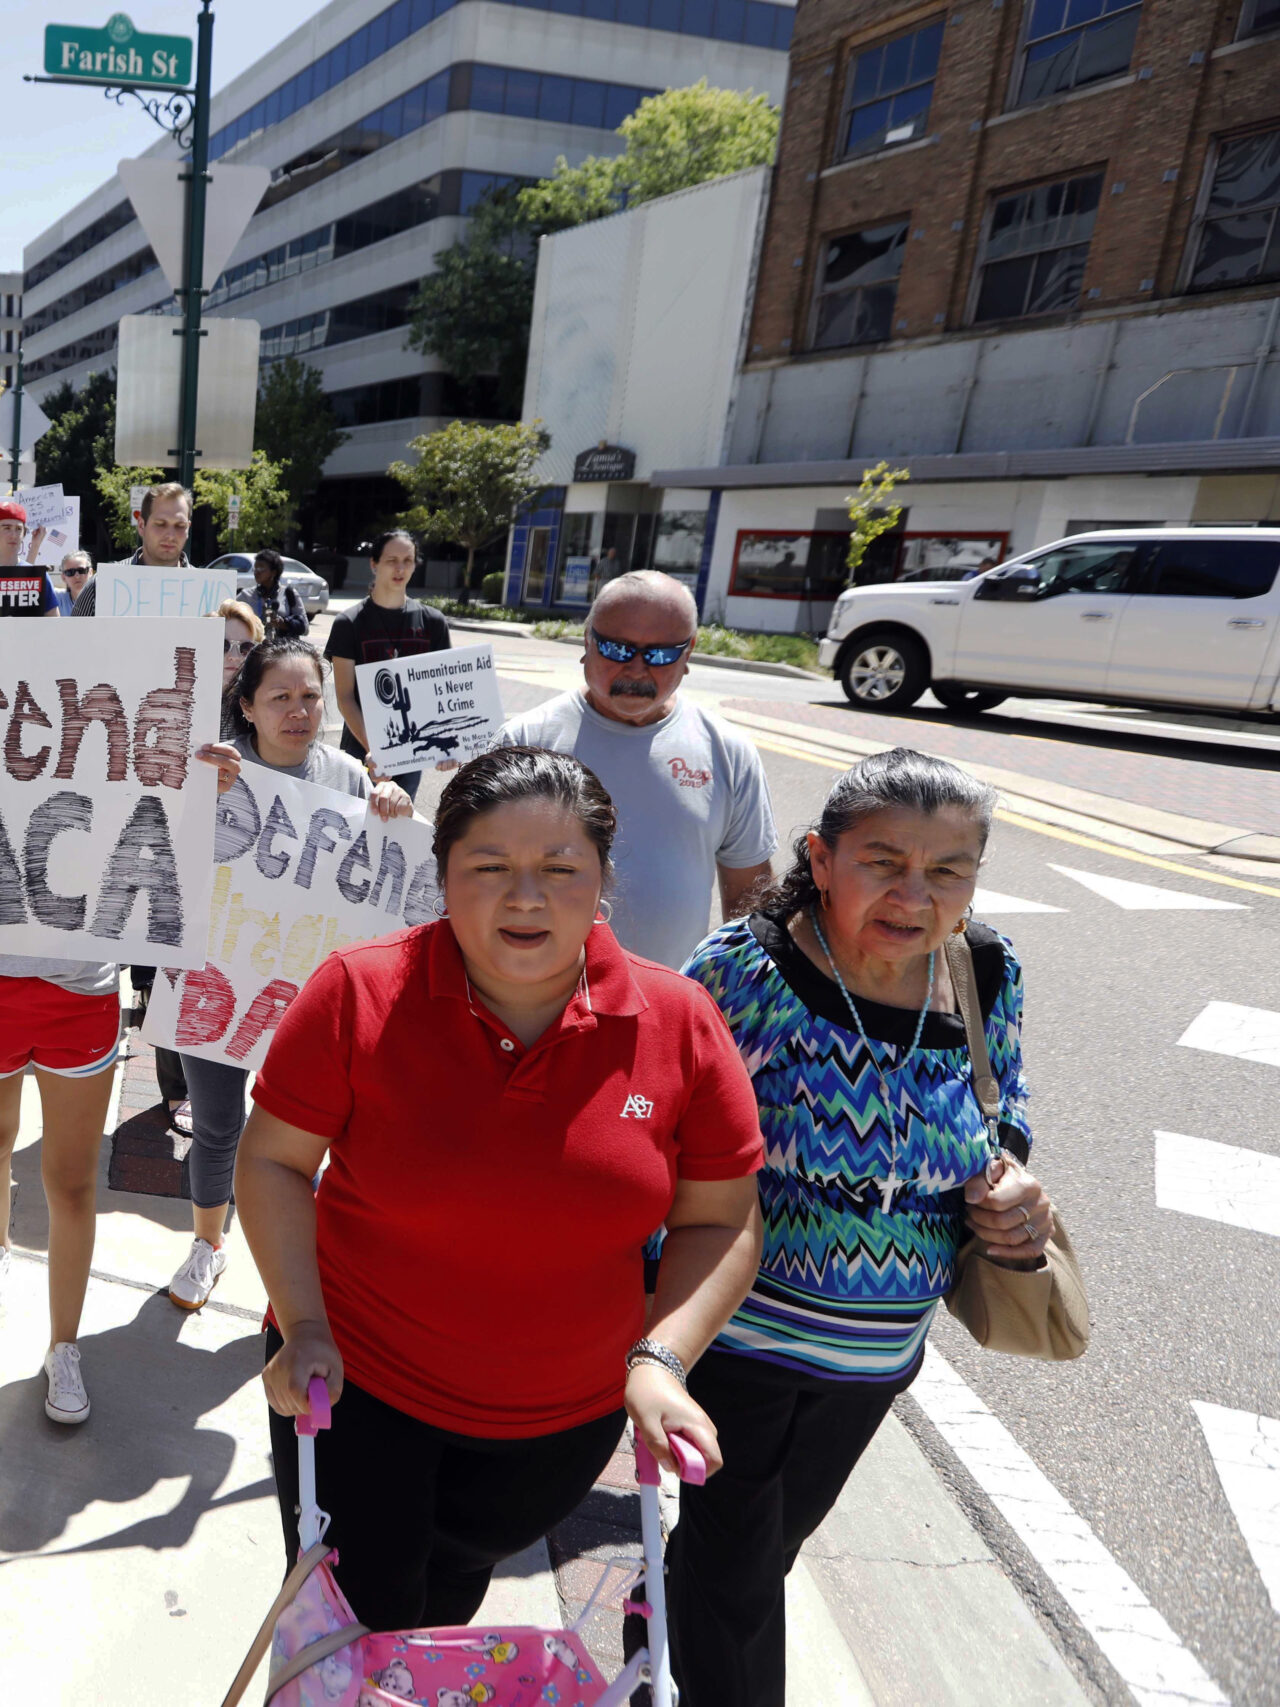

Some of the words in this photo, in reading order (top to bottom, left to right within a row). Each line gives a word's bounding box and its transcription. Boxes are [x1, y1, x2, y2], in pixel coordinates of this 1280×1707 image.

[61, 41, 143, 75] Farish
[151, 50, 179, 78] St
[407, 660, 473, 682] Humanitarian
[476, 655, 492, 670] Aid
[434, 683, 443, 696] Is
[446, 680, 474, 694] Never
[438, 702, 445, 714] A
[447, 699, 475, 713] Crime
[667, 757, 713, 785] Prep
